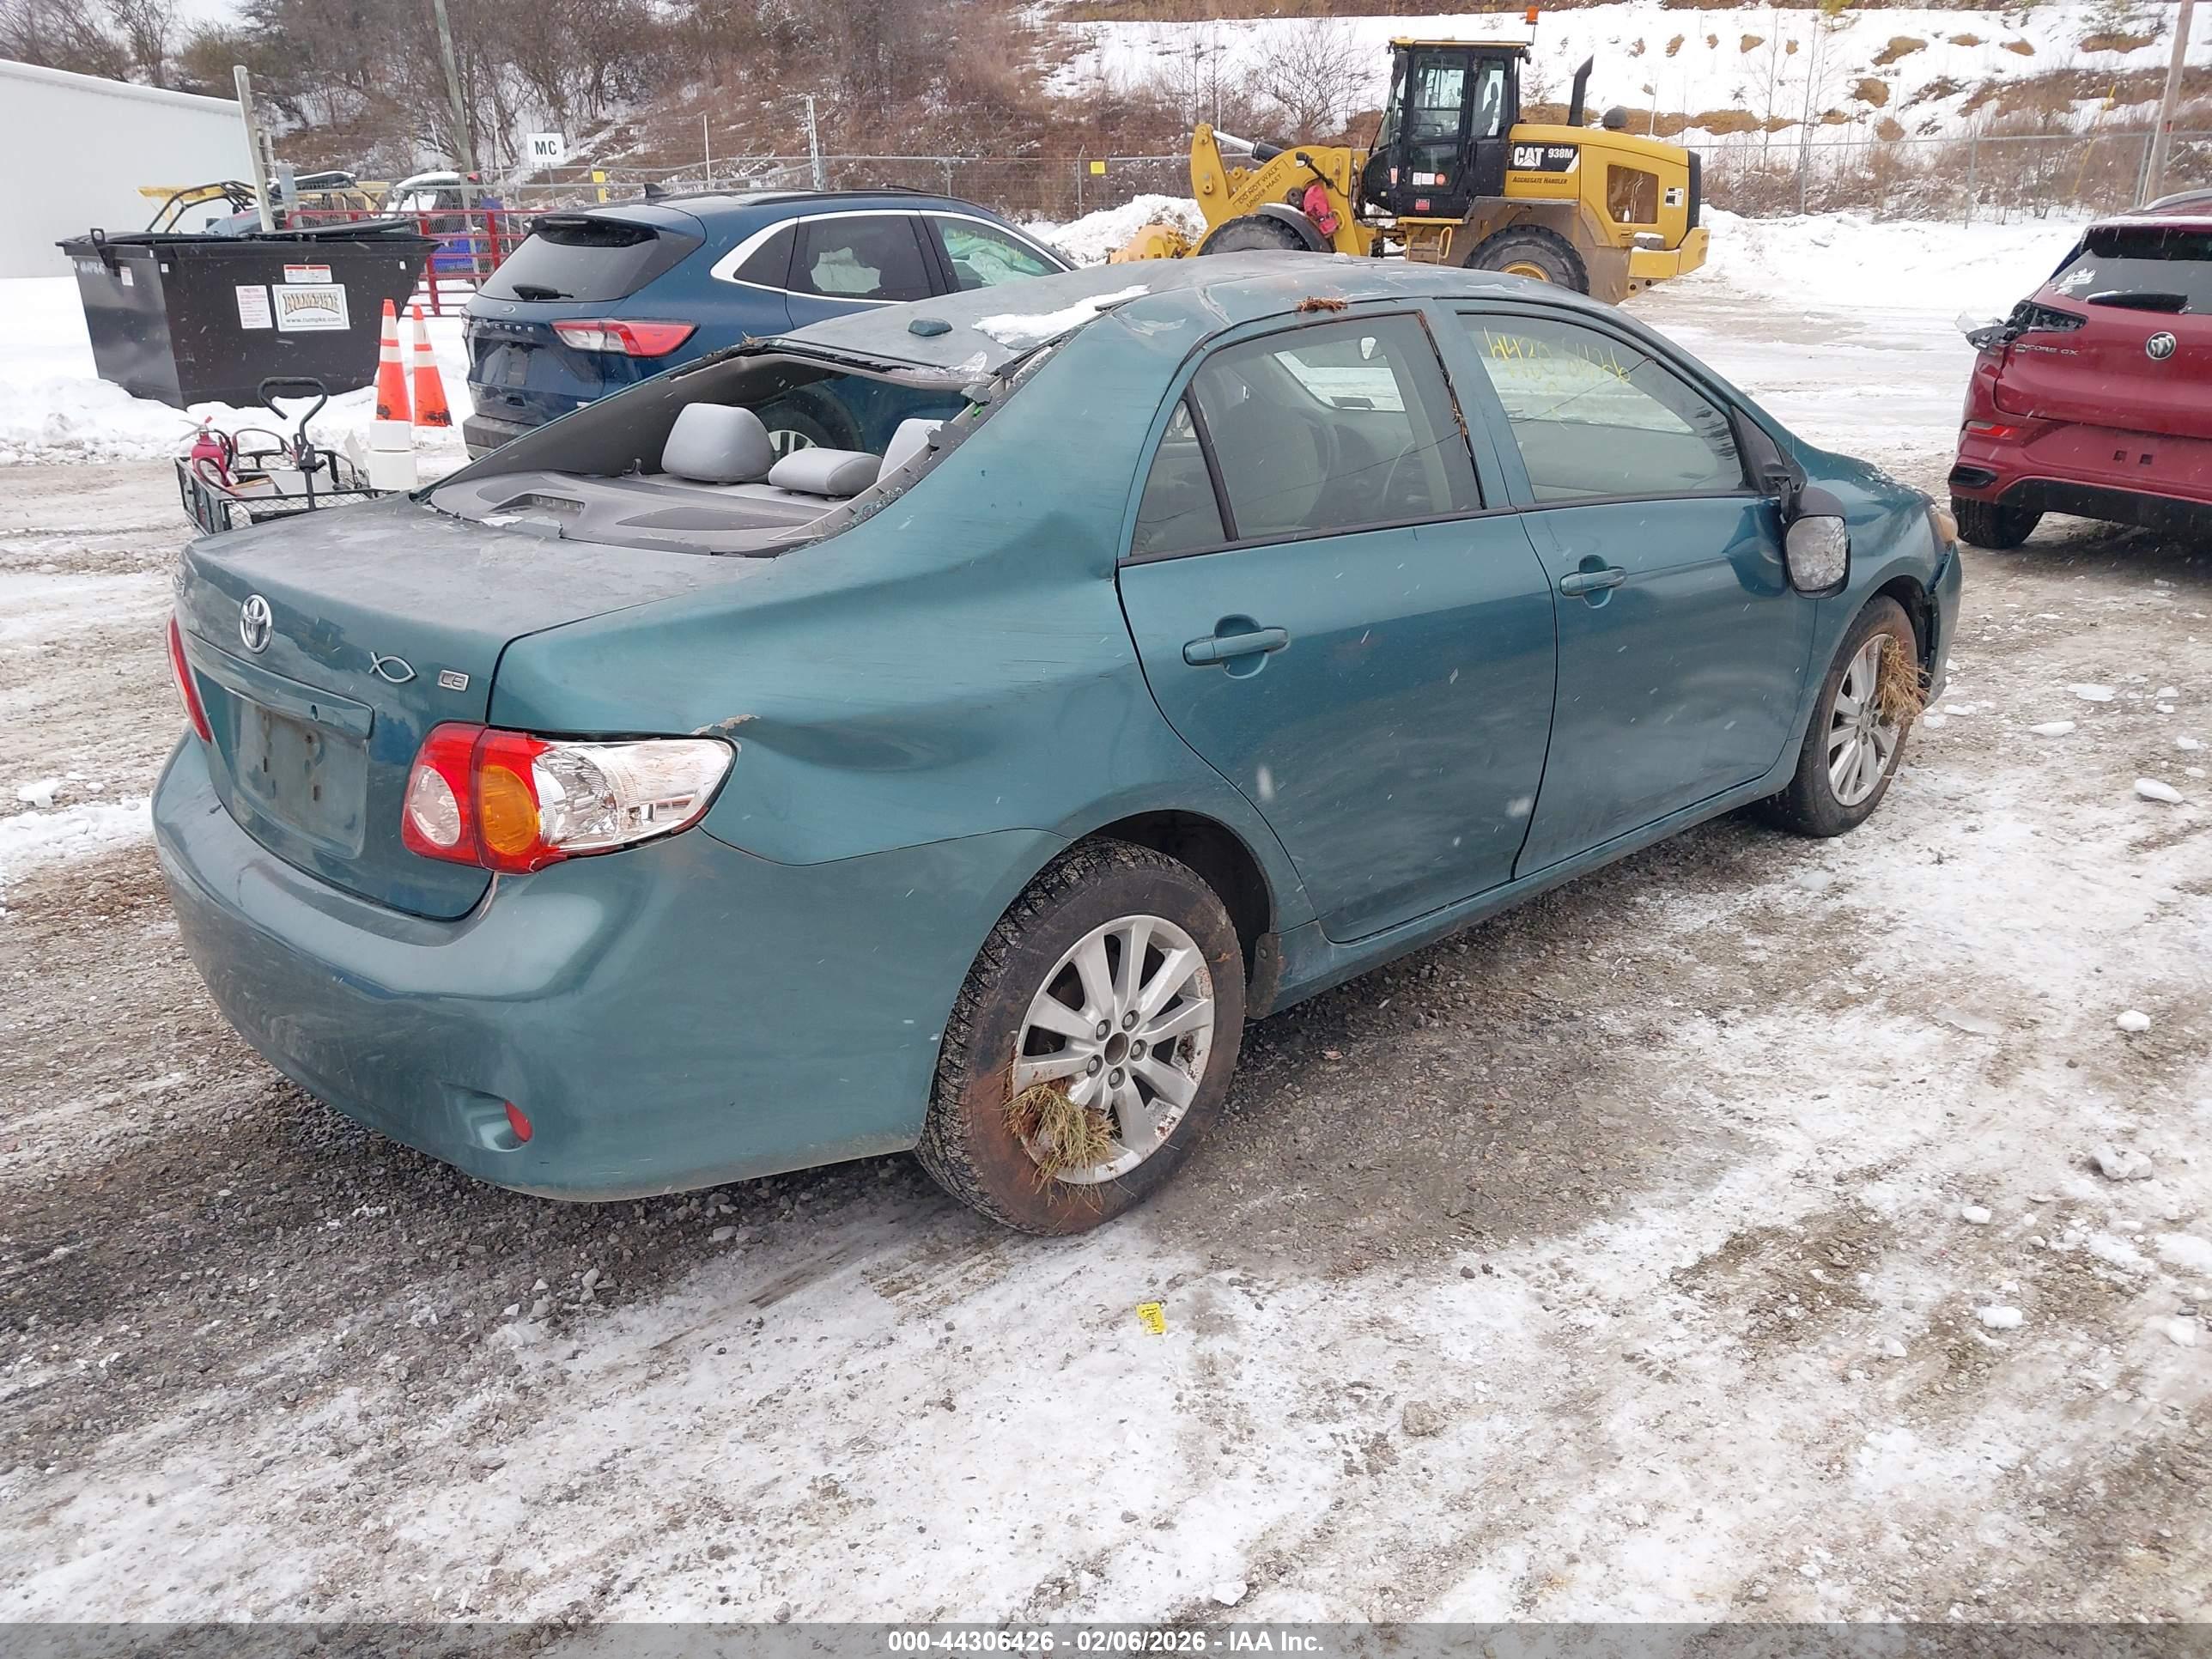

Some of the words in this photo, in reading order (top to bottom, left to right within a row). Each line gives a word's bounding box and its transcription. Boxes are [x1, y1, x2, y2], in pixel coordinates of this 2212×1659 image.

[534, 140, 556, 155] MC
[1514, 147, 1545, 167] CAT
[1548, 148, 1574, 159] 938M
[1238, 194, 1249, 204] DO
[1248, 179, 1261, 195] NOT
[1262, 165, 1279, 182] WALK
[1246, 189, 1267, 208] UNDER
[1267, 173, 1283, 190] MAST
[283, 292, 340, 316] RUMPKE
[441, 672, 465, 688] LE
